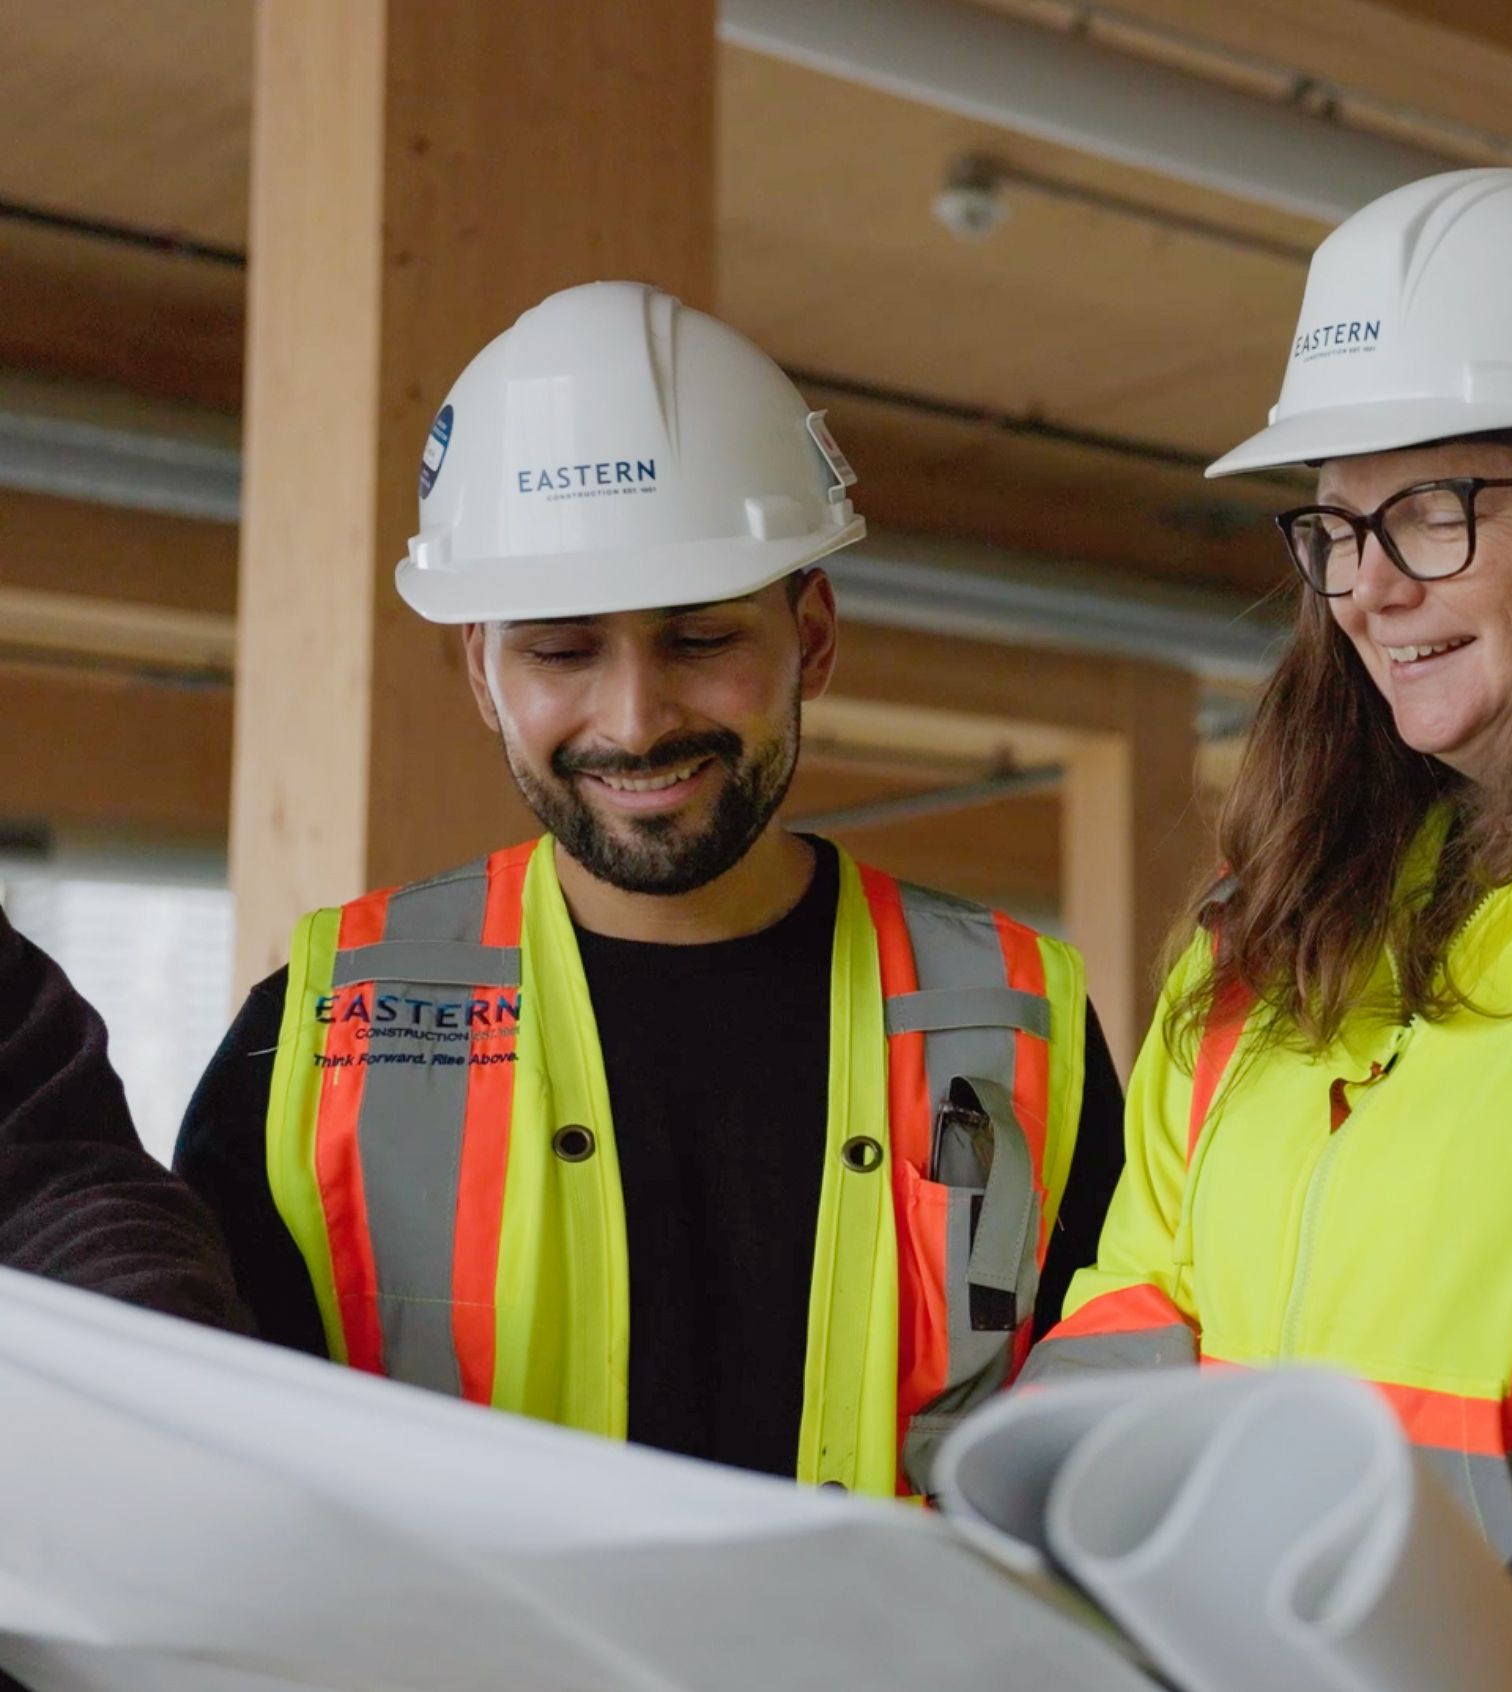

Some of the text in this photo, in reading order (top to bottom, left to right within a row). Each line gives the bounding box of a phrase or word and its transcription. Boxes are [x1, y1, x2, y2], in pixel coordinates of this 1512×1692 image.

[1294, 320, 1381, 358] EASTERN
[517, 458, 657, 494] EASTERN
[546, 488, 619, 502] CONSTRUCTION
[315, 994, 522, 1029] EASTERN
[355, 1027, 469, 1042] CONSTRUCTION
[314, 1054, 354, 1068] Think
[431, 1053, 465, 1066] Rise
